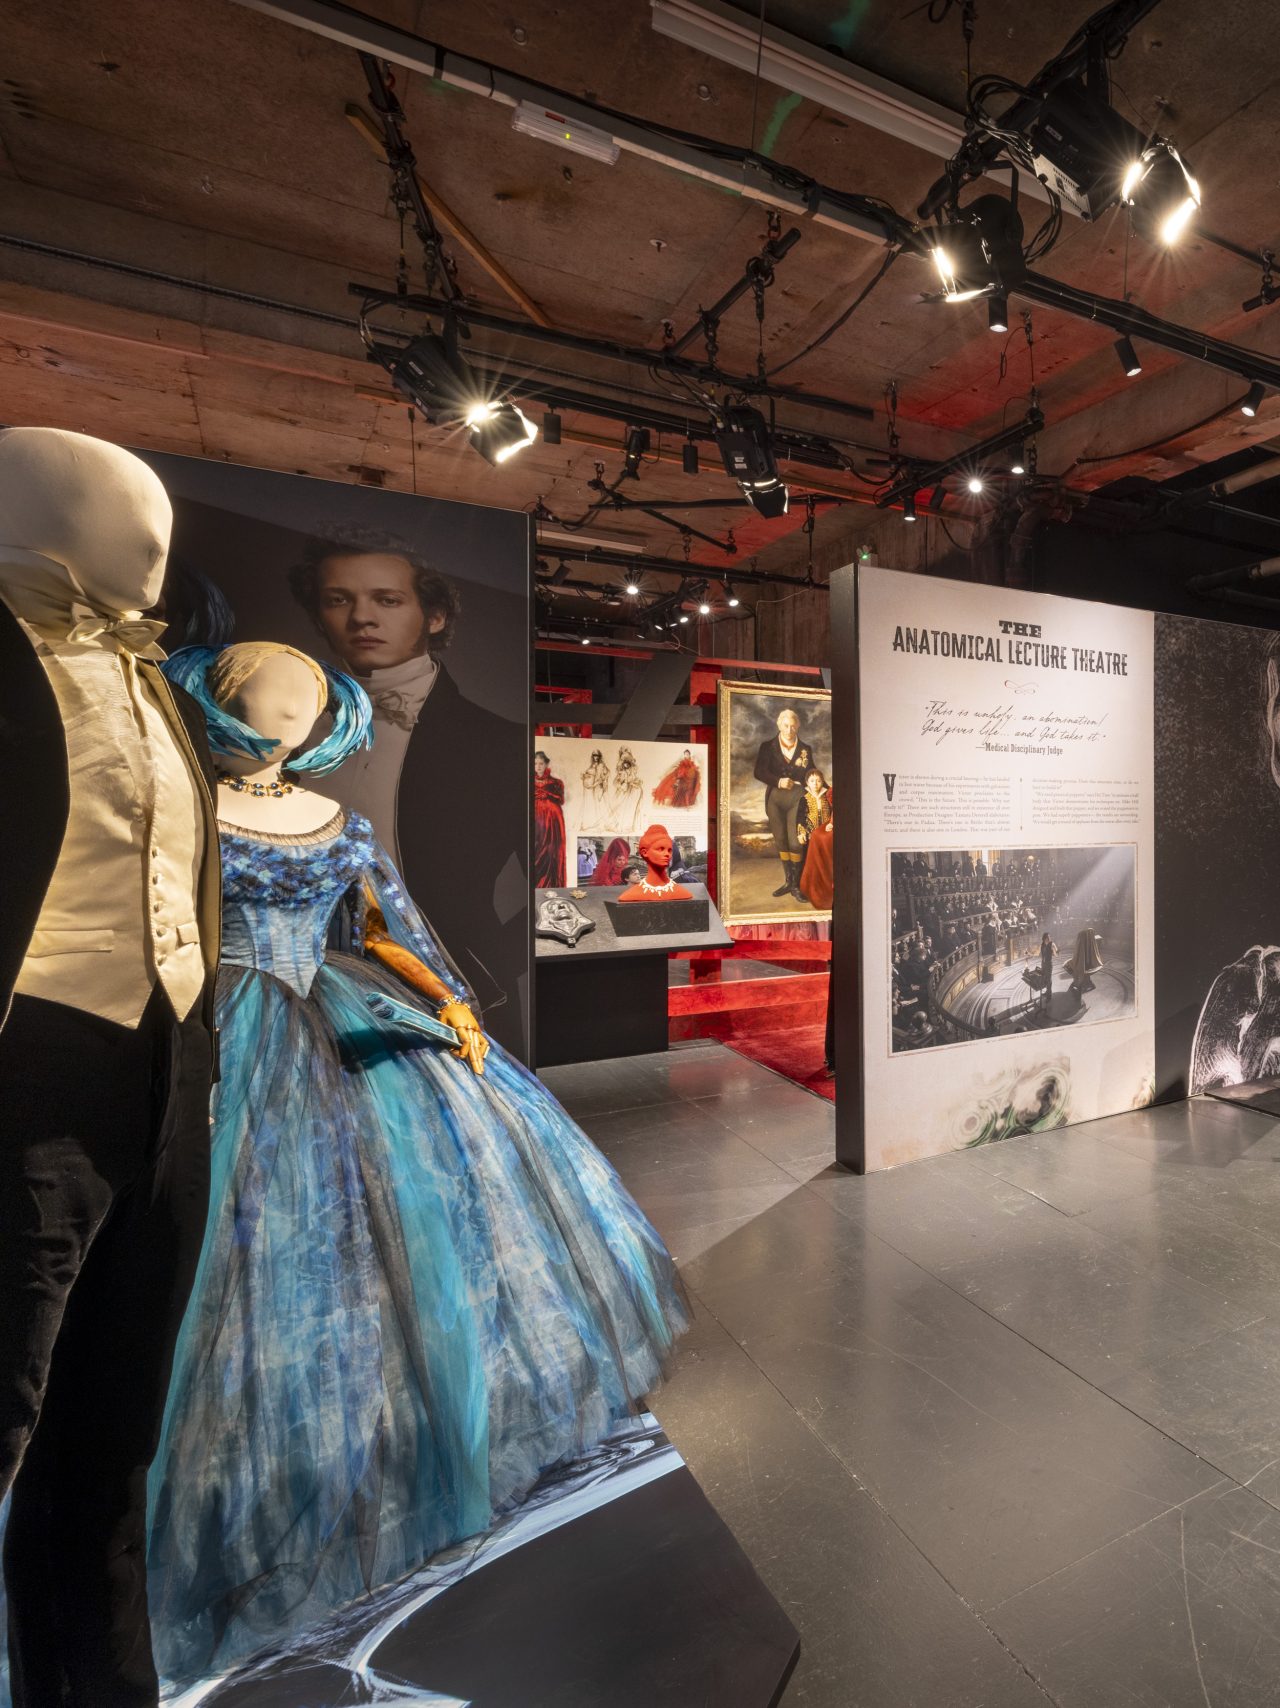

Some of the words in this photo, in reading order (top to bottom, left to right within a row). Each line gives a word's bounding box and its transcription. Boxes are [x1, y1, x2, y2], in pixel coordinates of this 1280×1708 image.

[998, 619, 1042, 639] THE
[892, 625, 1003, 663] ANATOMICAL
[1008, 639, 1068, 670] LECTURE
[1071, 647, 1129, 677] THEATRE
[957, 709, 969, 717] is
[1038, 711, 1109, 727] abomination!
[920, 718, 945, 736] God
[935, 725, 974, 746] gives
[1014, 727, 1037, 738] and
[1038, 726, 1059, 742] God
[1059, 728, 1083, 740] takes
[1010, 744, 1046, 756] Disciplinary
[1046, 745, 1064, 756] Judge
